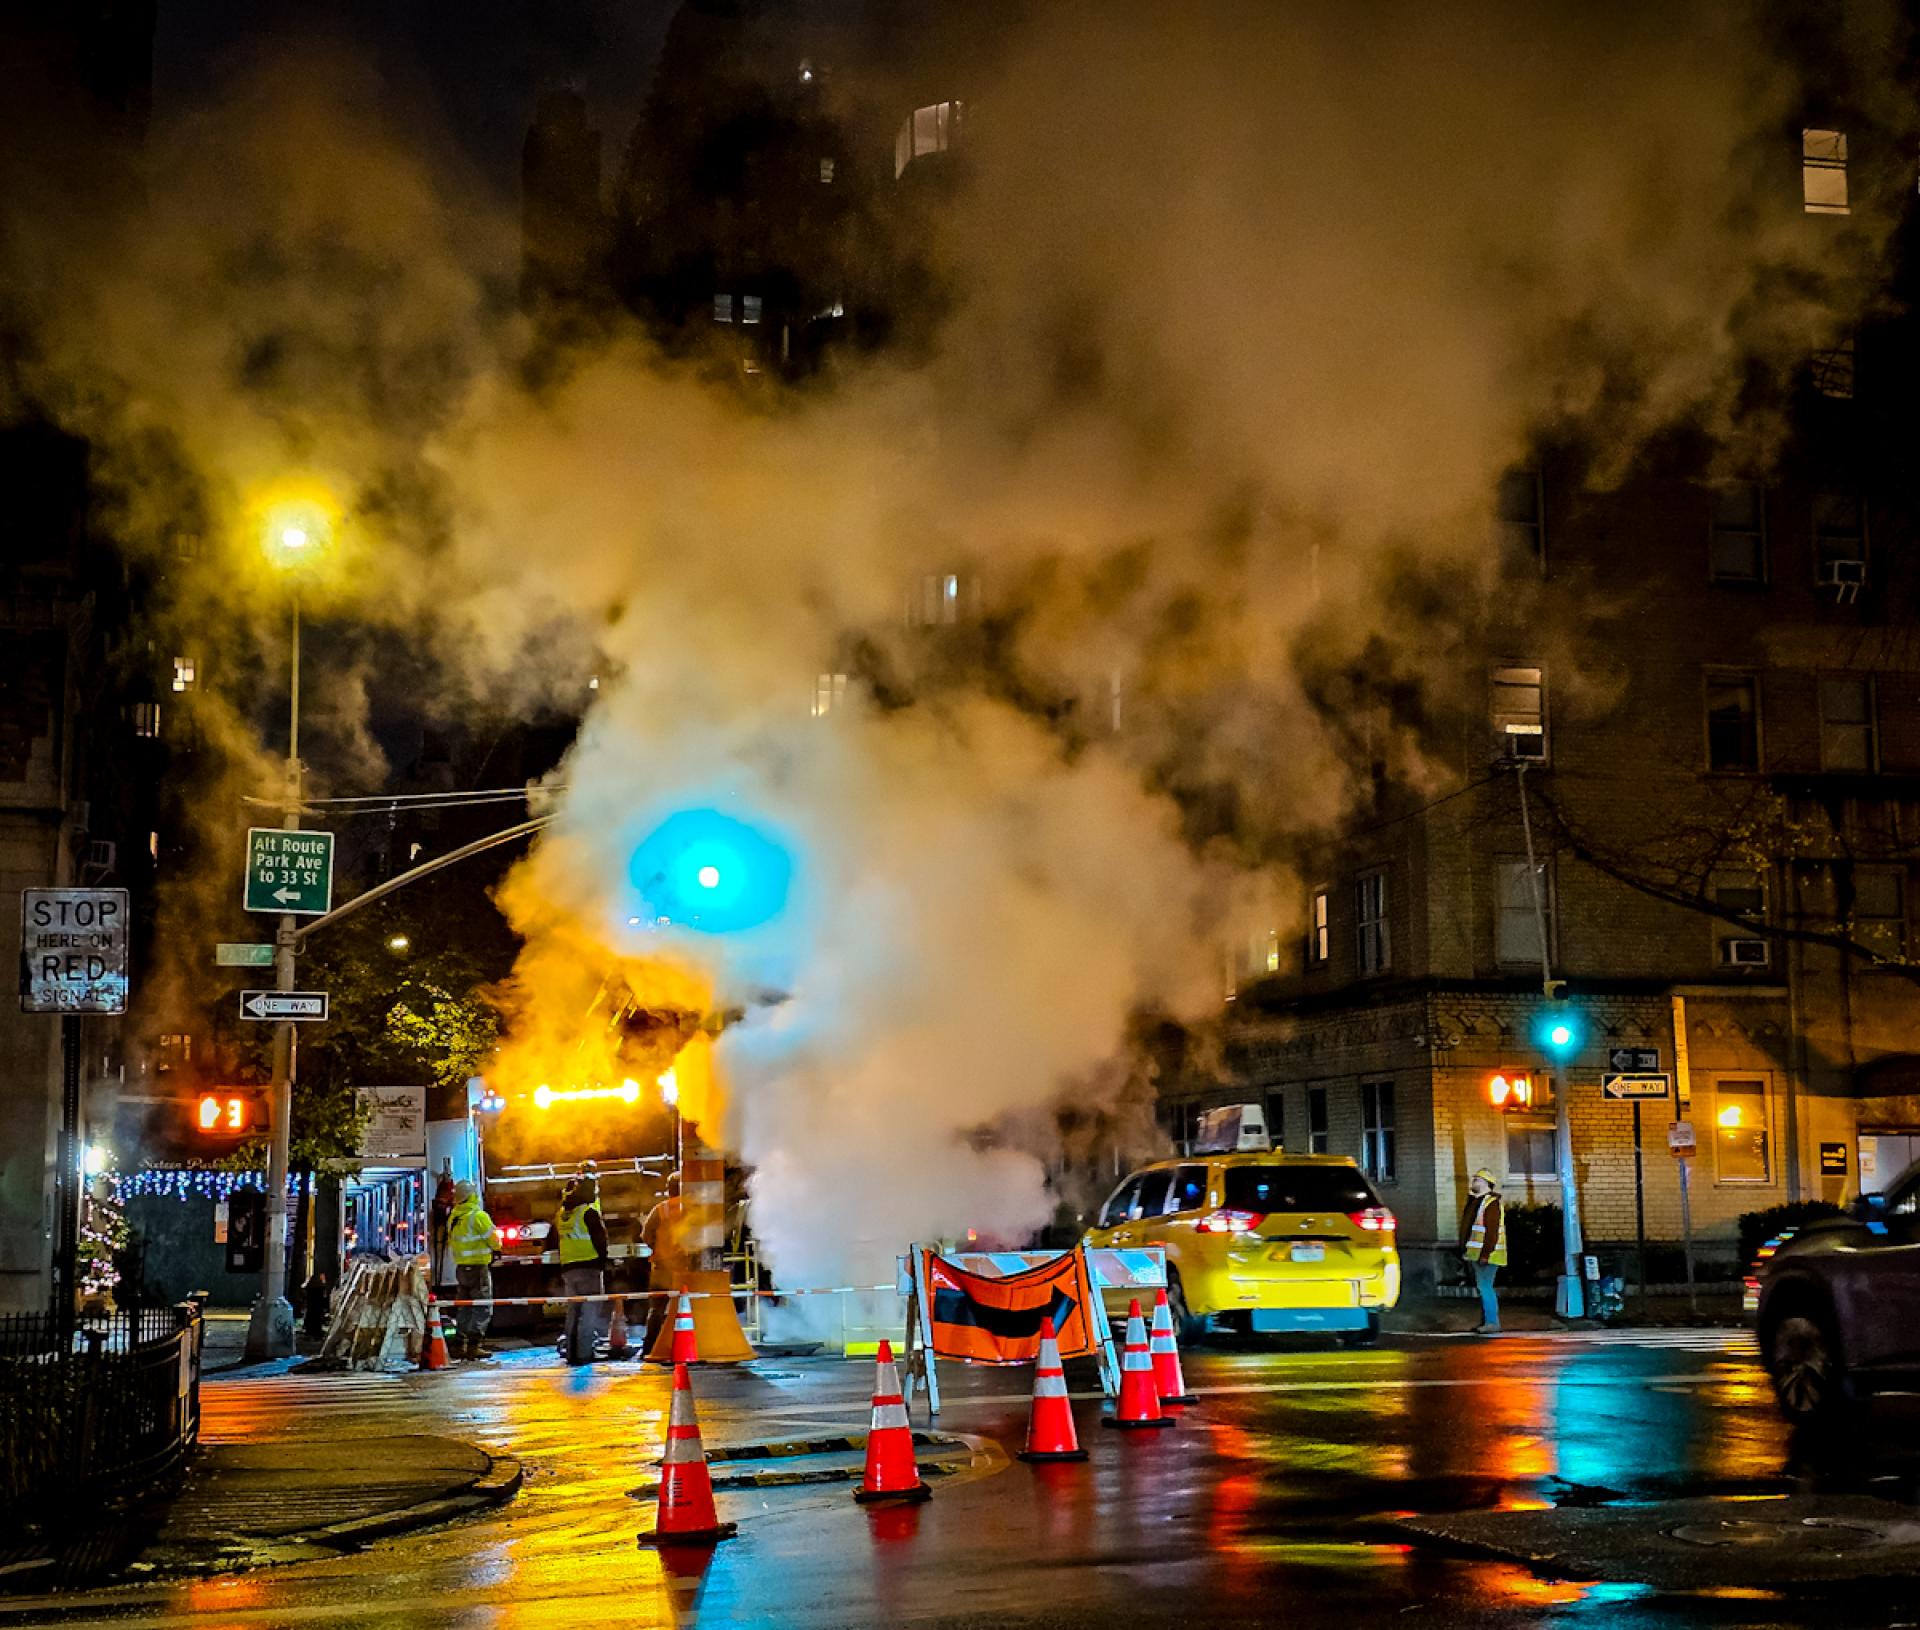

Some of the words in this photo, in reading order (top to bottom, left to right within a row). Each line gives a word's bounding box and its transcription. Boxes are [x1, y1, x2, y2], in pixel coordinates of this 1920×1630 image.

[255, 836, 276, 852] Alt
[282, 838, 326, 854] Route
[256, 853, 290, 868] Park
[295, 855, 323, 870] Ave
[259, 868, 275, 883] to
[279, 869, 298, 885] 33
[303, 871, 318, 886] St
[33, 900, 118, 927] STOP
[37, 933, 81, 948] HERE
[89, 933, 113, 948] ON
[42, 954, 107, 981] RED
[42, 989, 106, 1003] SIGNAL
[255, 1000, 278, 1010] ONE
[290, 1000, 317, 1010] WAY
[1613, 1082, 1632, 1092] ONE
[1640, 1082, 1663, 1092] WAY
